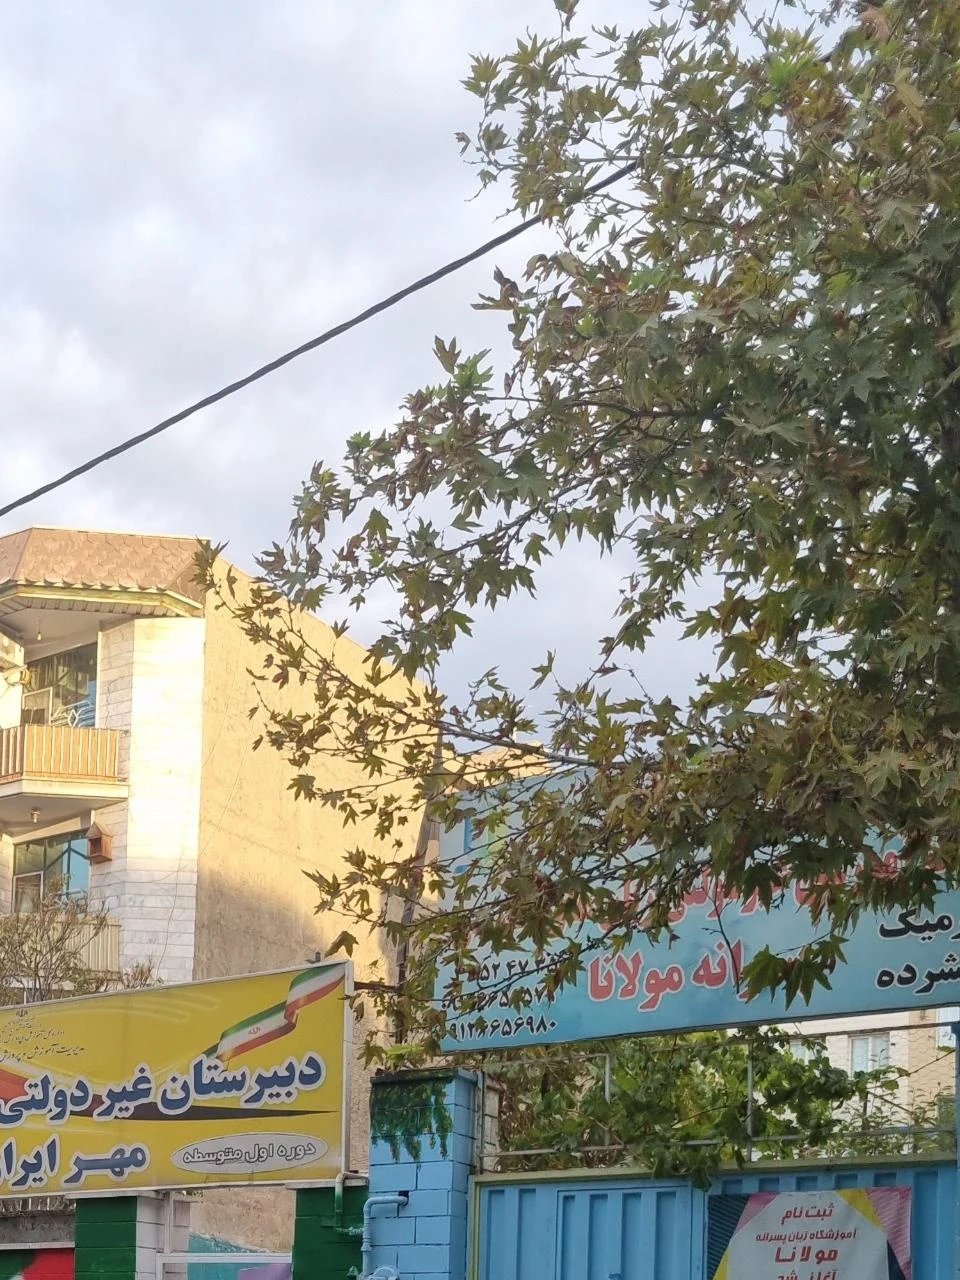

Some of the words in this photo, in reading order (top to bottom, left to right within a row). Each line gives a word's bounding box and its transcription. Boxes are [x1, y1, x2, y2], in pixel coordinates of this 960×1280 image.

[589, 951, 684, 1010] مولانا
[876, 953, 960, 995] شرده
[96, 1066, 153, 1117] غیر
[160, 1055, 323, 1111] دبیرستان
[182, 1148, 242, 1166] متوسطه
[244, 1143, 274, 1164] اول
[276, 1142, 317, 1161] دوره
[63, 1146, 148, 1185] مهر
[781, 1206, 803, 1225] نام
[805, 1202, 834, 1219] ثبت
[755, 1232, 787, 1244] پسرانه
[788, 1231, 808, 1243] زبان
[775, 1246, 838, 1264] مولانا
